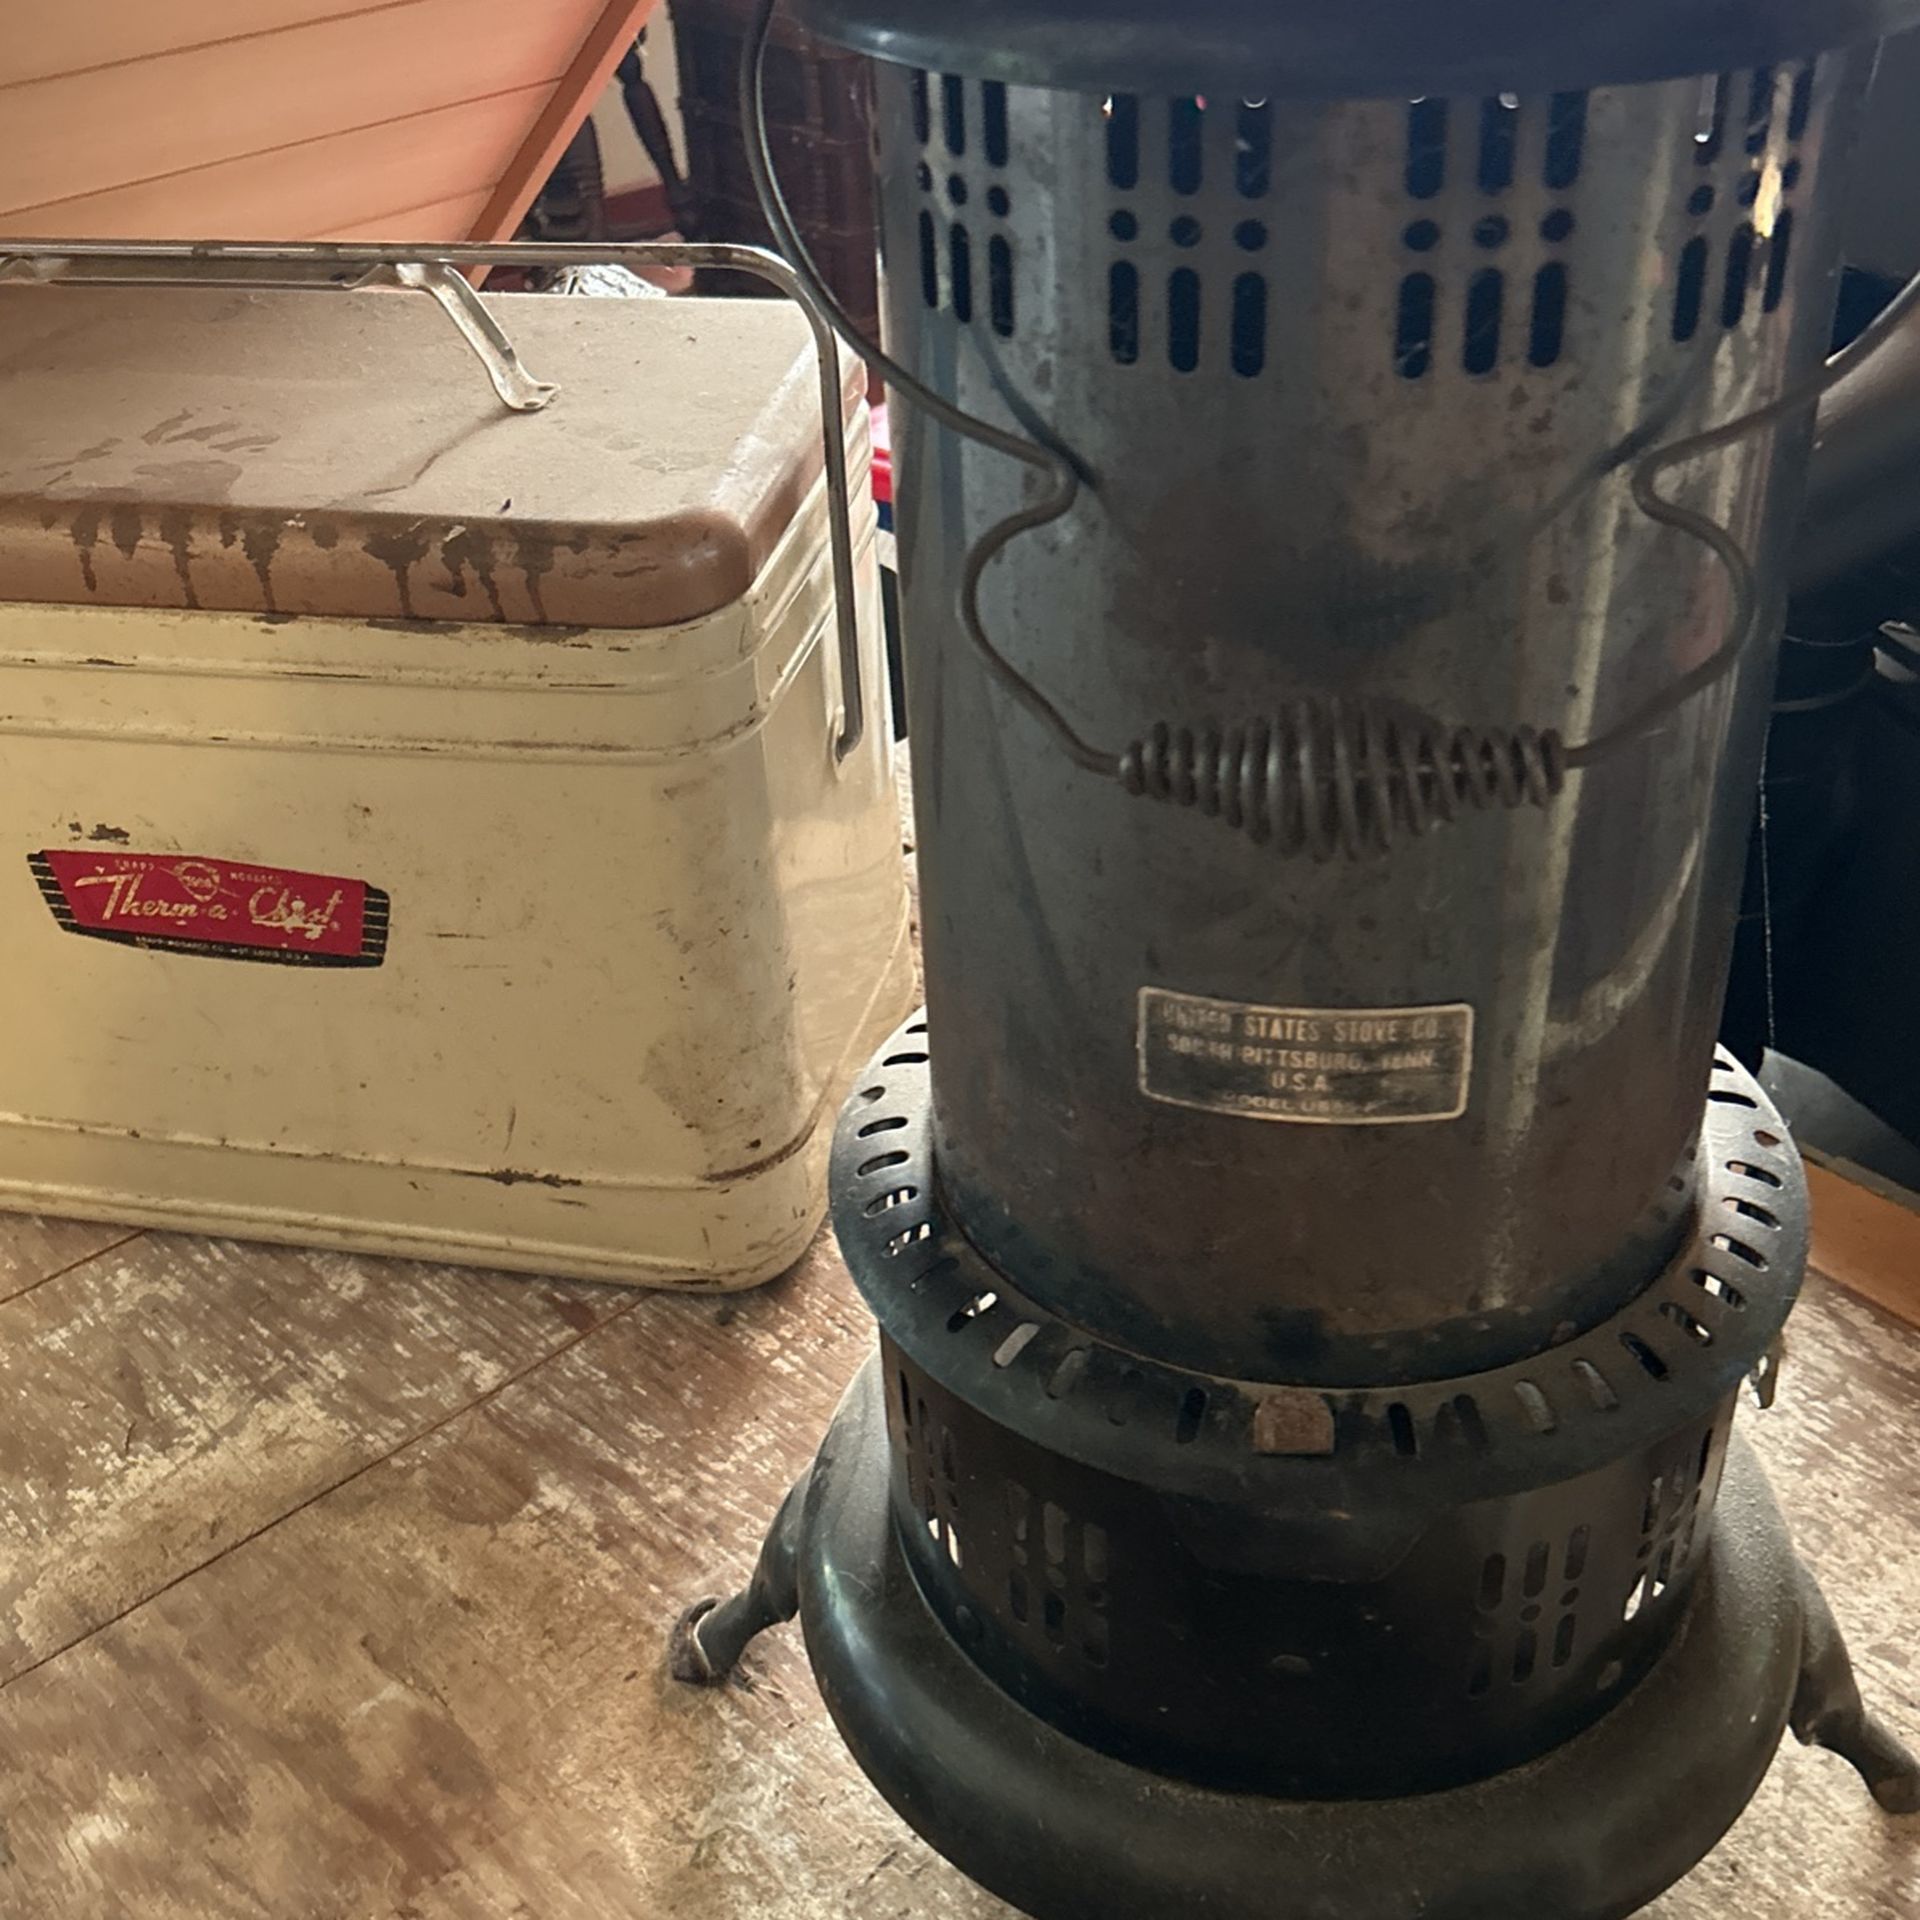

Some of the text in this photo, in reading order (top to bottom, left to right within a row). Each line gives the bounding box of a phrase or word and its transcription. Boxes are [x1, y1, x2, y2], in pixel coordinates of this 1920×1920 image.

[248, 886, 344, 926] Chst
[1243, 1014, 1321, 1042] STATES
[1332, 1019, 1400, 1043] STOVE
[1410, 1016, 1446, 1040] CO.
